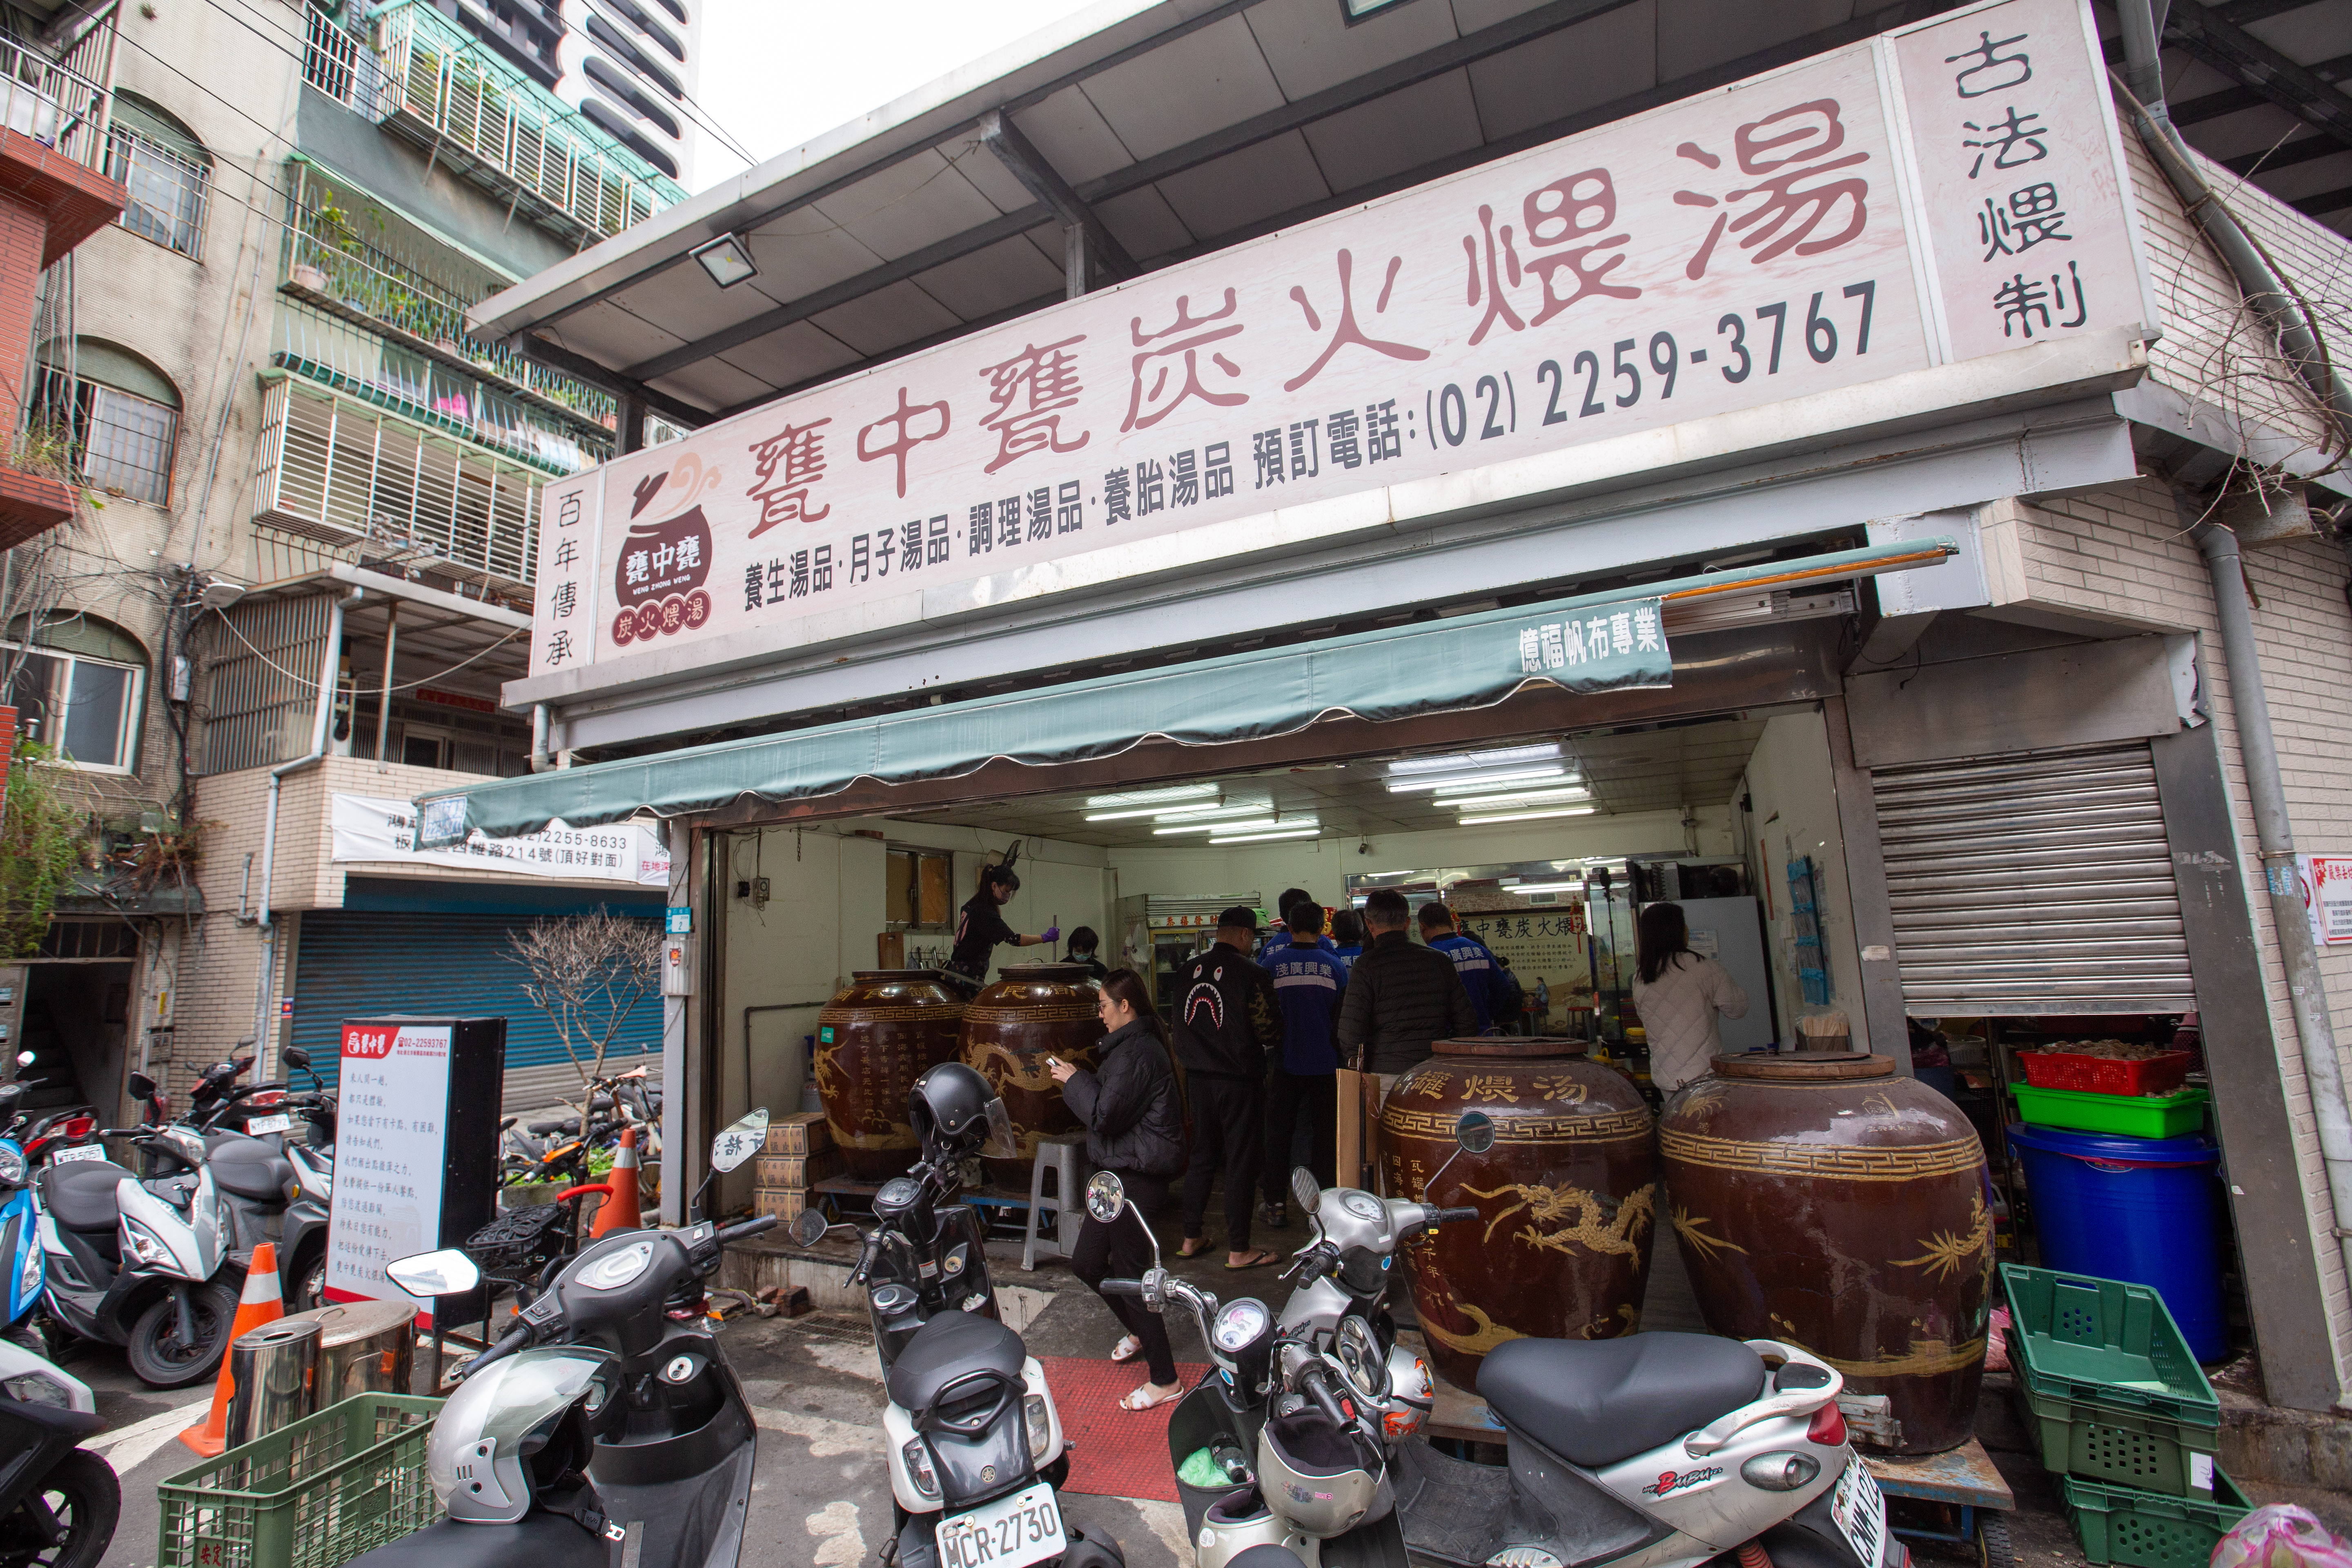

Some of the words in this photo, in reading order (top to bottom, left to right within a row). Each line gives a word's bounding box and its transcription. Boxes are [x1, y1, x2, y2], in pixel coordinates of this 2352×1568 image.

[1944, 30, 2087, 338] 古法煨制
[746, 98, 1870, 539] 甕中甕炭火煨湯
[1537, 279, 1875, 427] 2259-3767
[546, 490, 584, 666] 百年傳承
[626, 535, 701, 585] 甕中甕
[633, 585, 649, 595] WENG
[651, 579, 671, 591] ZHONG
[673, 574, 691, 584] WENG
[617, 597, 704, 639] 炭火煨湯
[1519, 606, 1659, 673] 億福帆布專業
[395, 833, 623, 868] 板四維路214號(頂好對面)
[678, 922, 683, 930] 2
[1275, 961, 1332, 978] 淺廣興業
[404, 1038, 447, 1048] 02-22593767
[200, 1543, 222, 1567] 安定
[943, 1502, 1057, 1568] MCR-2730
